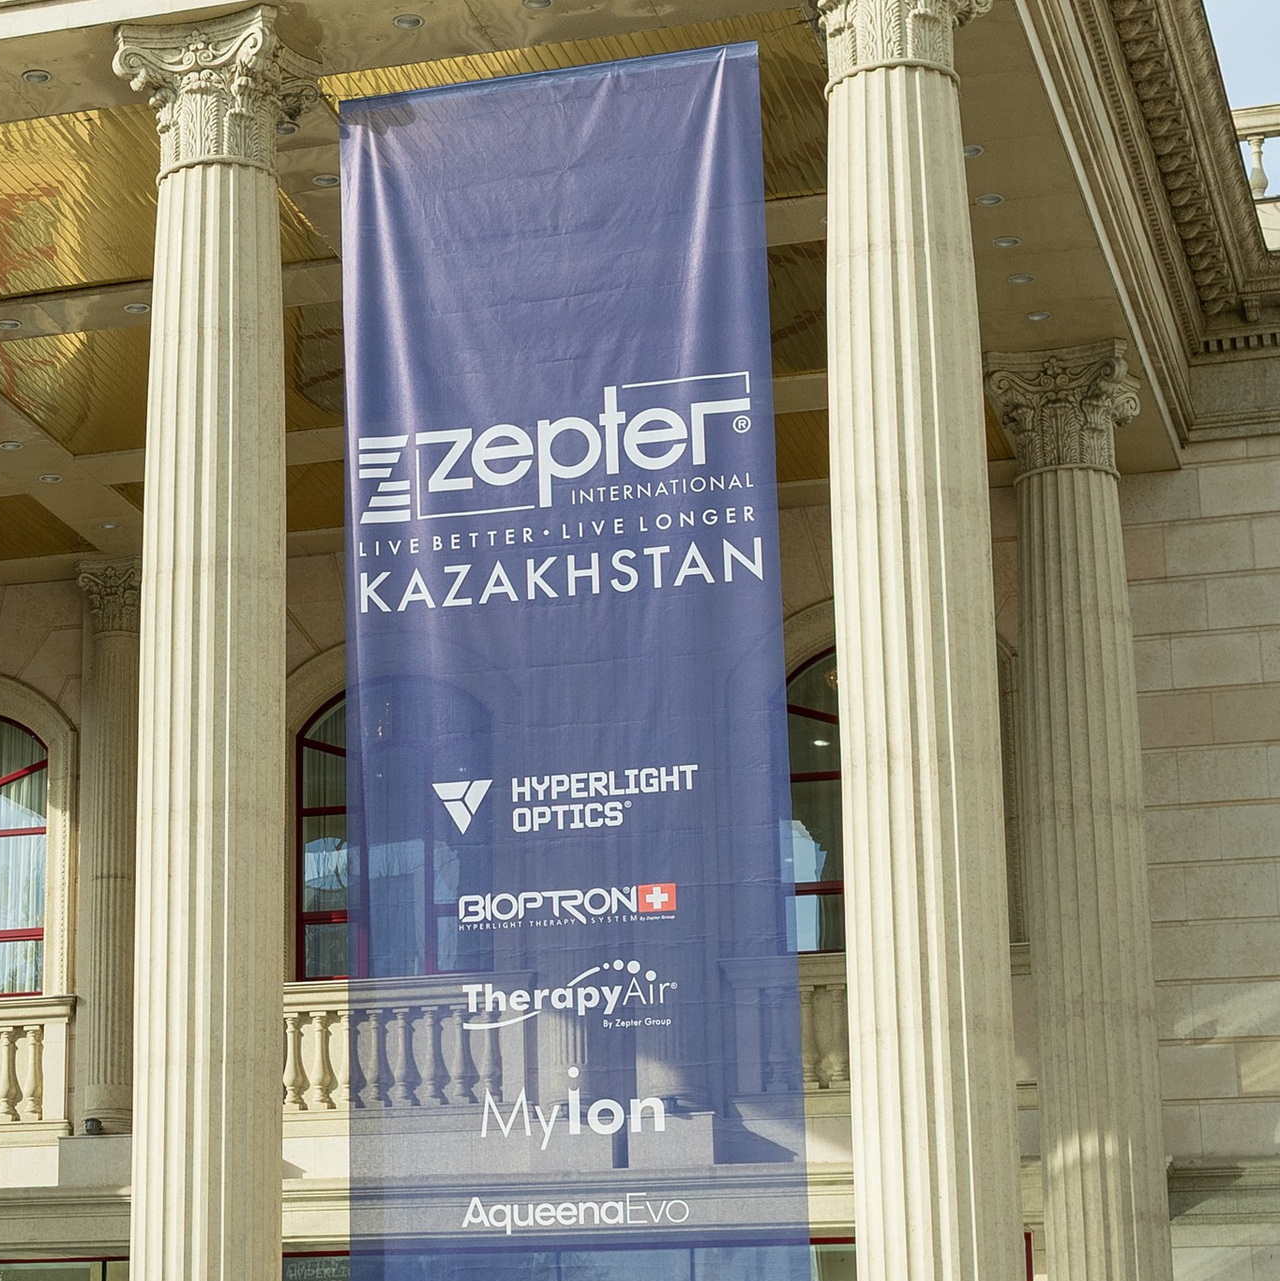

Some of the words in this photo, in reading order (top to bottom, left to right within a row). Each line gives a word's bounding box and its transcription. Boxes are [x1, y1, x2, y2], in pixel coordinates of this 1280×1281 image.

[415, 386, 751, 508] zepter
[571, 472, 755, 505] INTERNATIONAL
[359, 537, 420, 557] LIVE
[433, 527, 534, 551] BETTER
[562, 518, 624, 539] LIVE
[639, 505, 756, 532] LONGER
[360, 536, 764, 614] KAZAKHSTAN
[511, 764, 699, 802] HYPERLIGHT
[512, 801, 624, 833] OPTICS
[458, 885, 637, 925] BIOPTRON
[458, 921, 523, 931] HYPERLIGHT
[529, 918, 577, 927] THERAPY
[590, 915, 638, 924] SYSTEM
[603, 1019, 612, 1029] By
[615, 1019, 642, 1028] Zepter
[644, 1017, 671, 1027] Group
